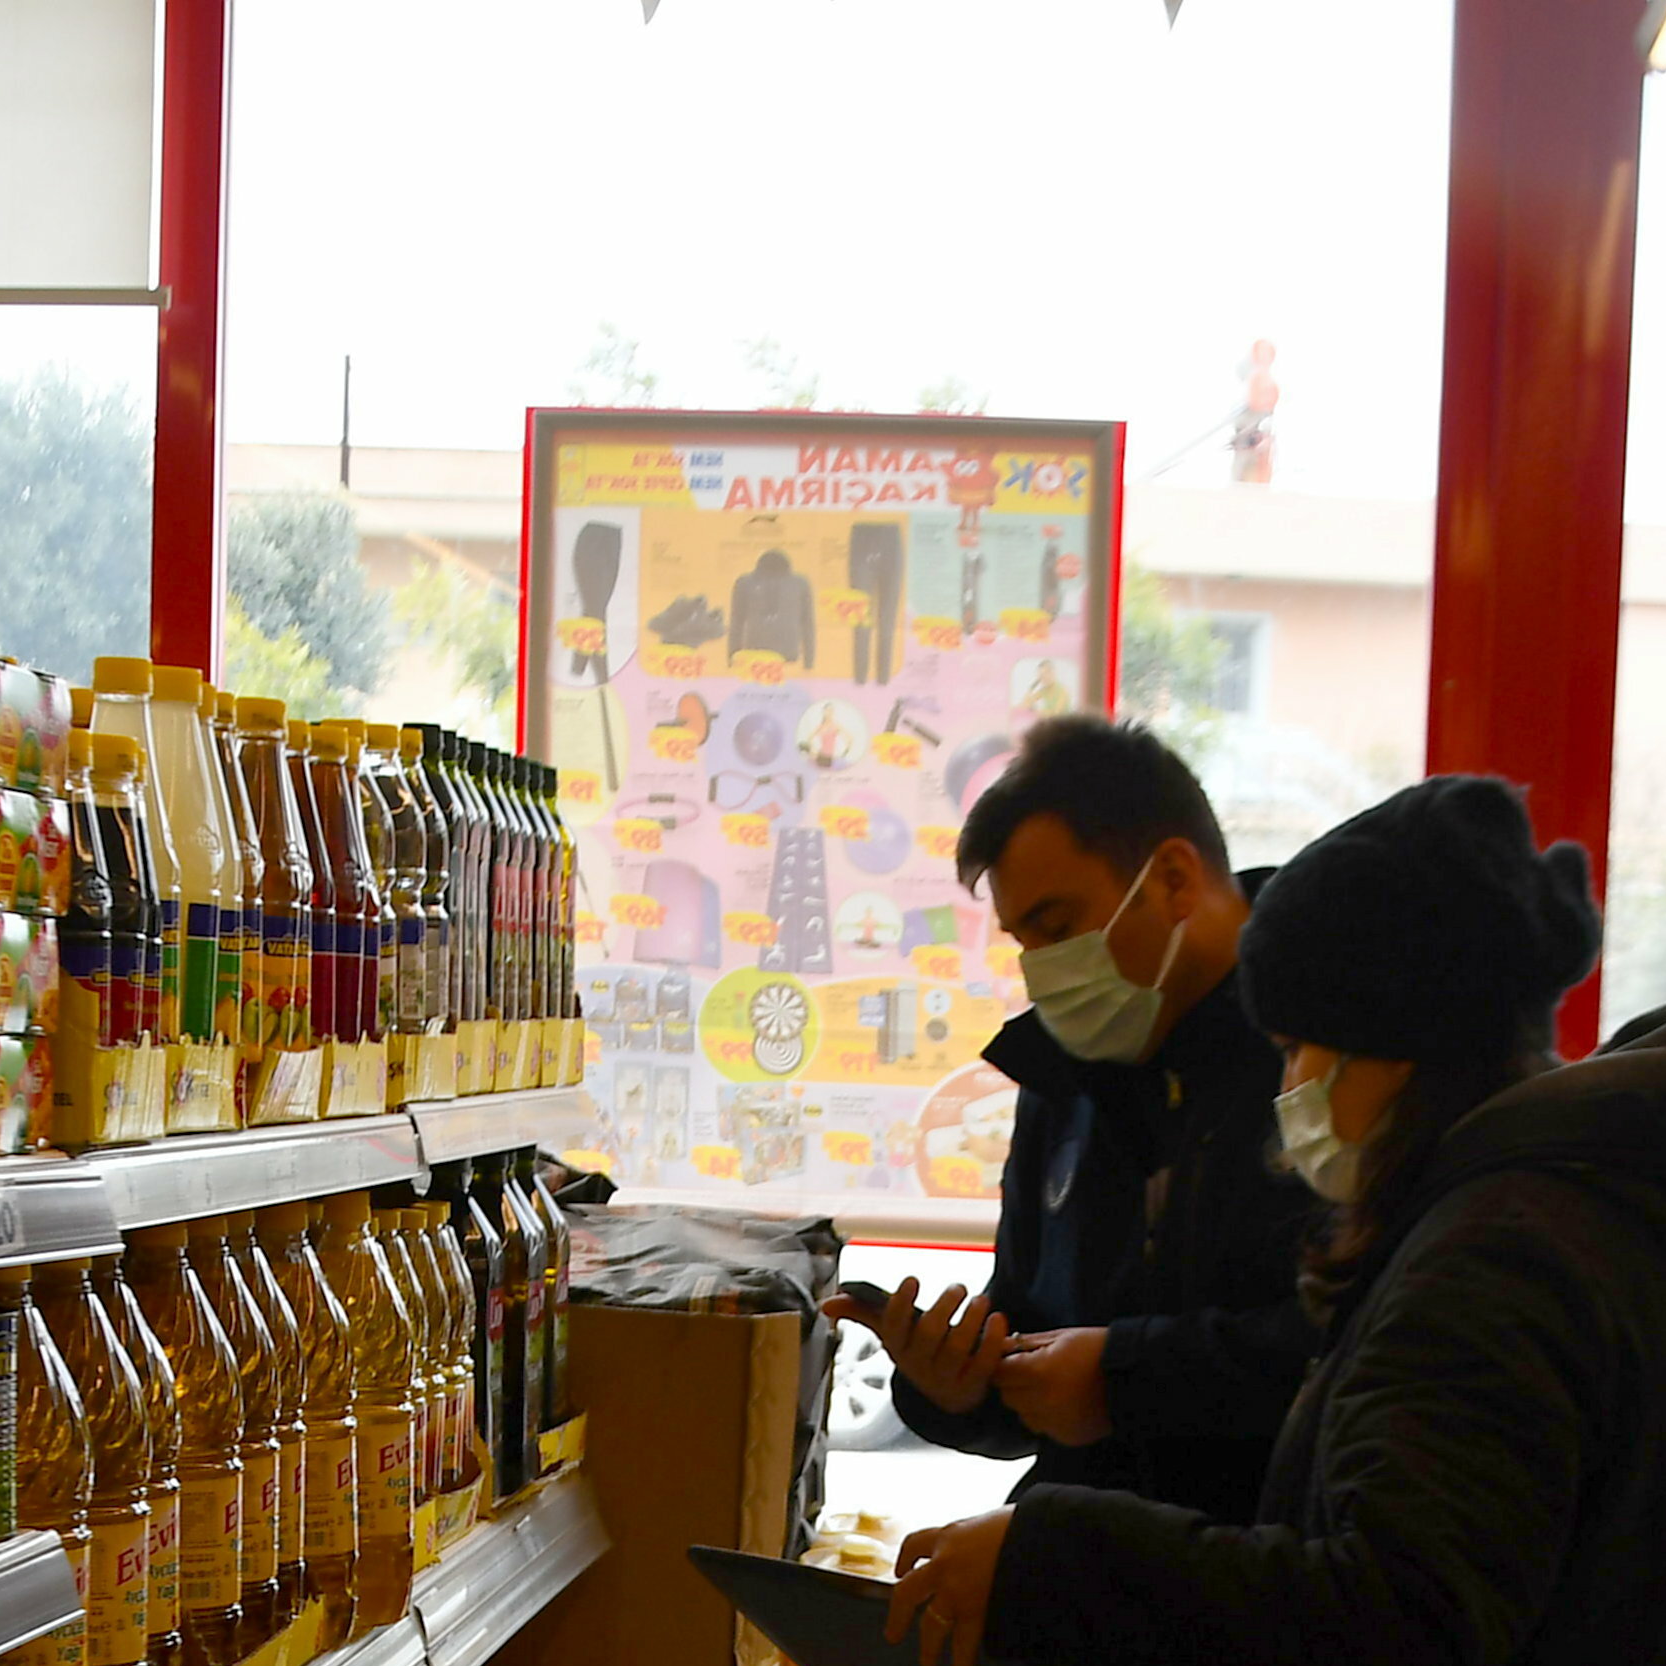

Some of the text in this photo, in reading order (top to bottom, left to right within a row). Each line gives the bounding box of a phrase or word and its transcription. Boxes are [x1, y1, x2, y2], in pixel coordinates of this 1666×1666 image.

[379, 1438, 411, 1472] Evi
[148, 1512, 176, 1556] Evi
[117, 1549, 144, 1586] Ev
